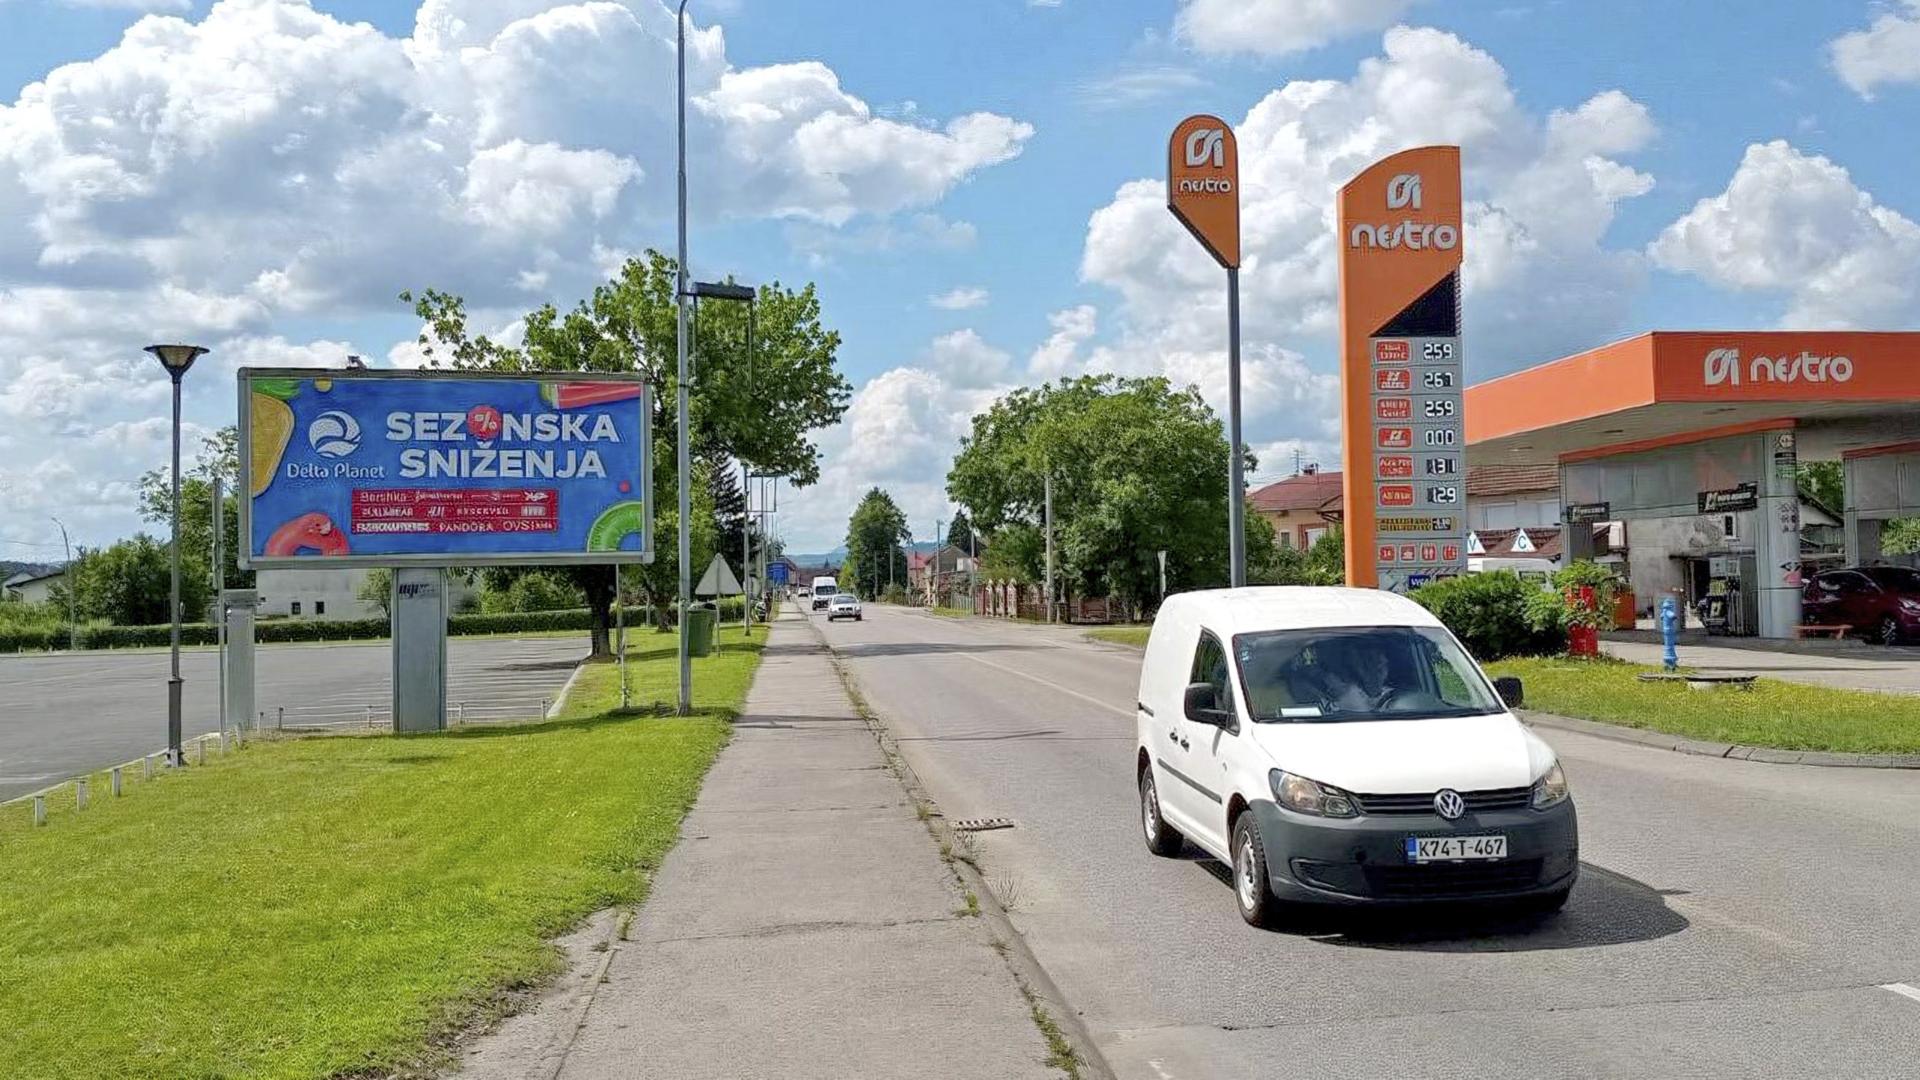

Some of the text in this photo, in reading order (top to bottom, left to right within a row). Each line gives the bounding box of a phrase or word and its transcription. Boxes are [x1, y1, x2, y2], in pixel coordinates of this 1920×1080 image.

[1180, 177, 1231, 194] nestro
[1351, 221, 1457, 250] nestro
[1750, 352, 1853, 383] nestro
[399, 441, 607, 479] SNIŽENJA
[286, 462, 386, 480] Delta Planet
[439, 522, 494, 533] PANDORA
[1418, 839, 1504, 857] K74-T-467
